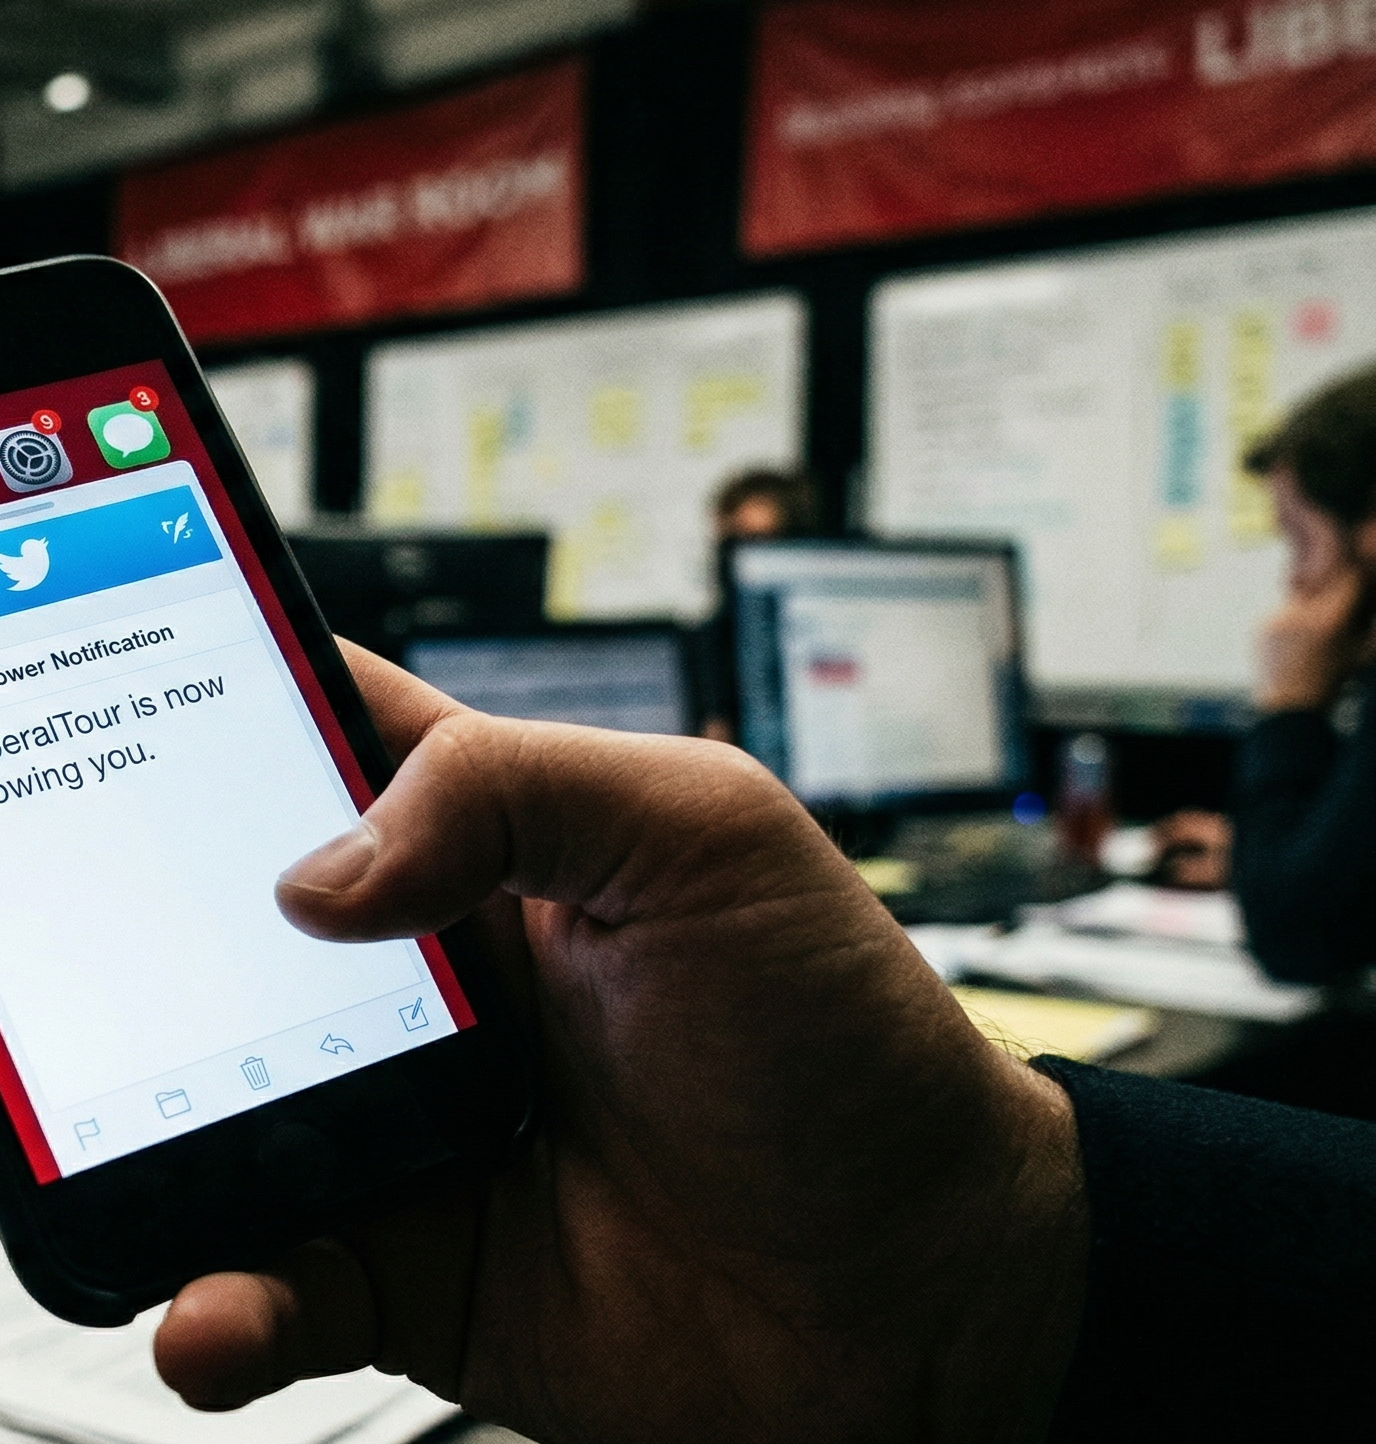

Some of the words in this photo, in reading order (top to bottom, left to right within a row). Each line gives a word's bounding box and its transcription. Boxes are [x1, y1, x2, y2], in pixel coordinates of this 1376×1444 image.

[136, 390, 151, 406] 3
[39, 414, 54, 430] 9
[50, 626, 175, 672] Notification
[127, 693, 157, 719] is
[163, 675, 225, 710] now
[87, 742, 156, 783] you.
